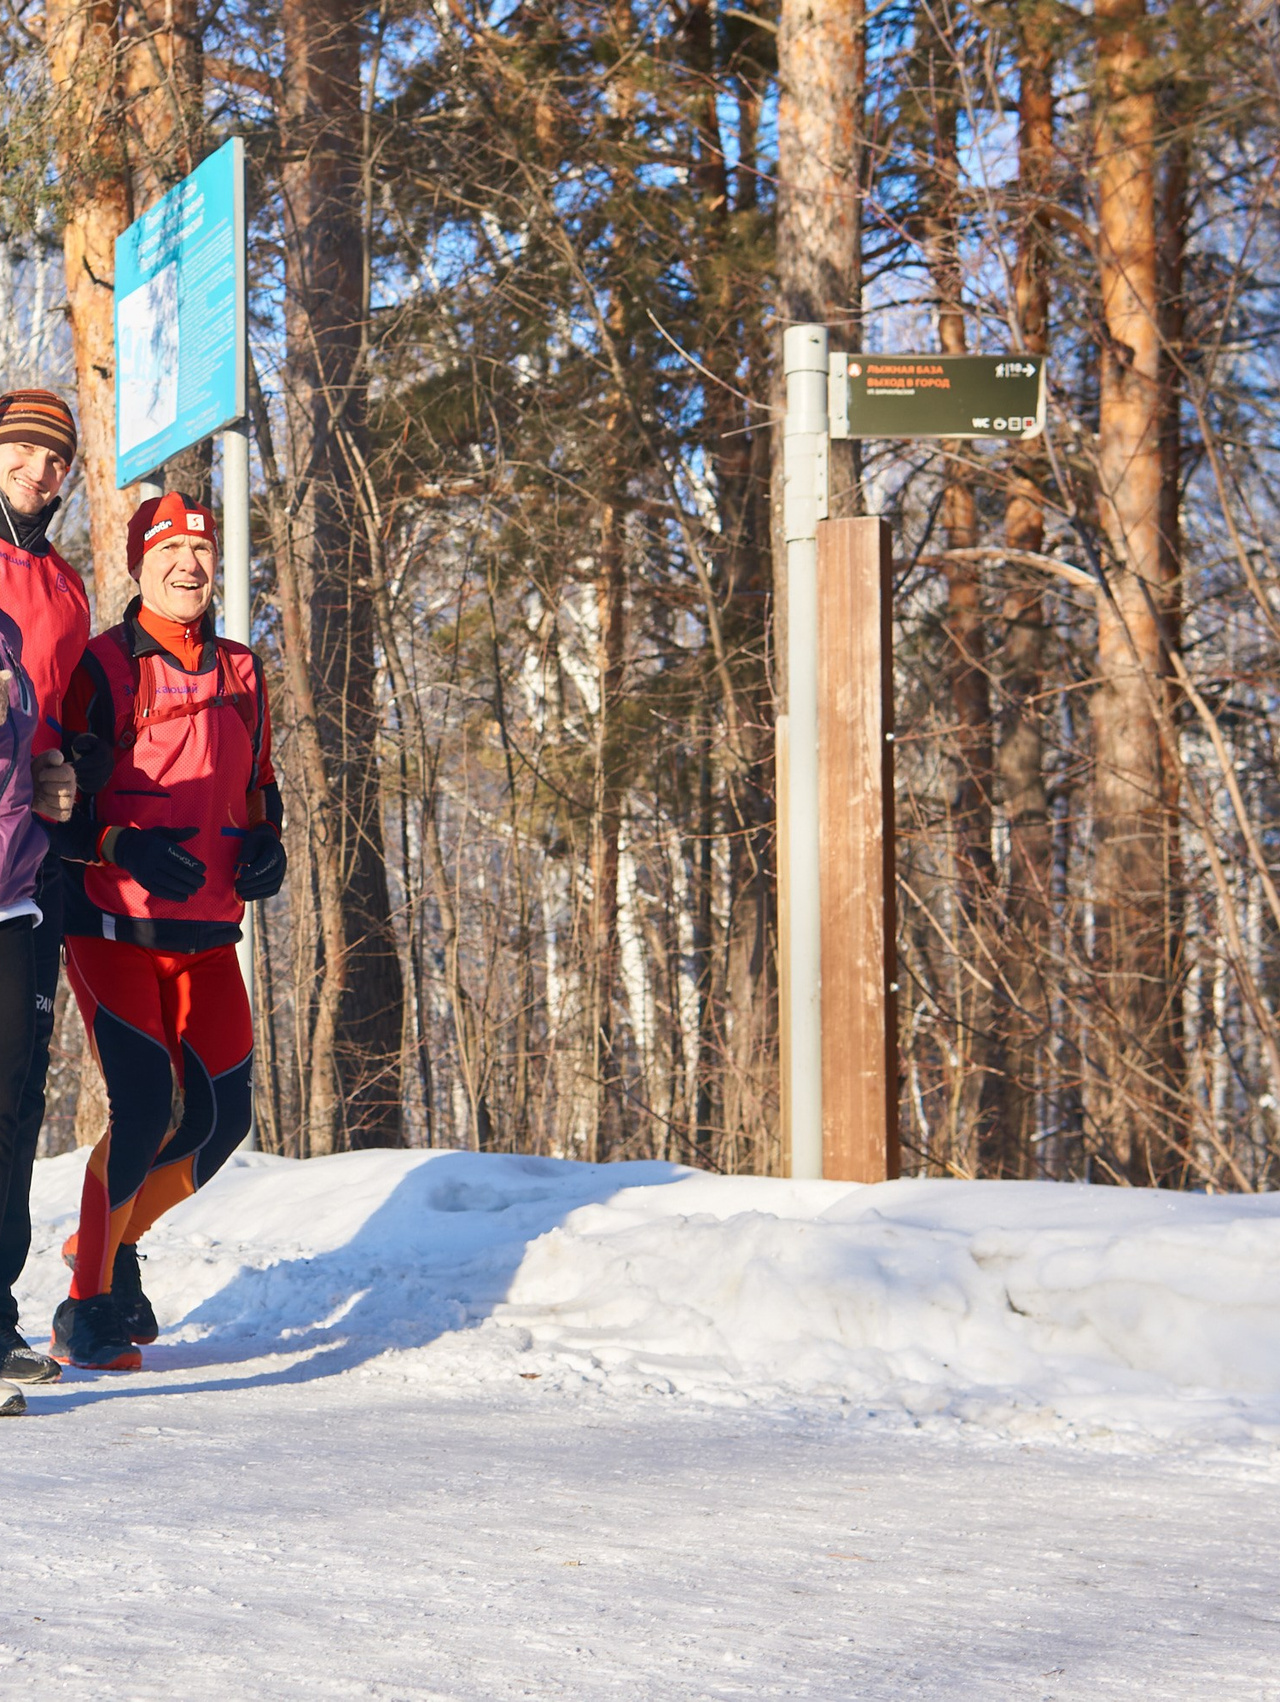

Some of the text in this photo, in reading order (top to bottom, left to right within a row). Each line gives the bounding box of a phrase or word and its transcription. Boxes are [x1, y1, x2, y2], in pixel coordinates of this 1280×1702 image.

[866, 364, 944, 375] ЛЫЖНАЯ БАЗА
[866, 378, 951, 390] ВЫХОД В ГОРОД
[972, 417, 990, 428] WC
